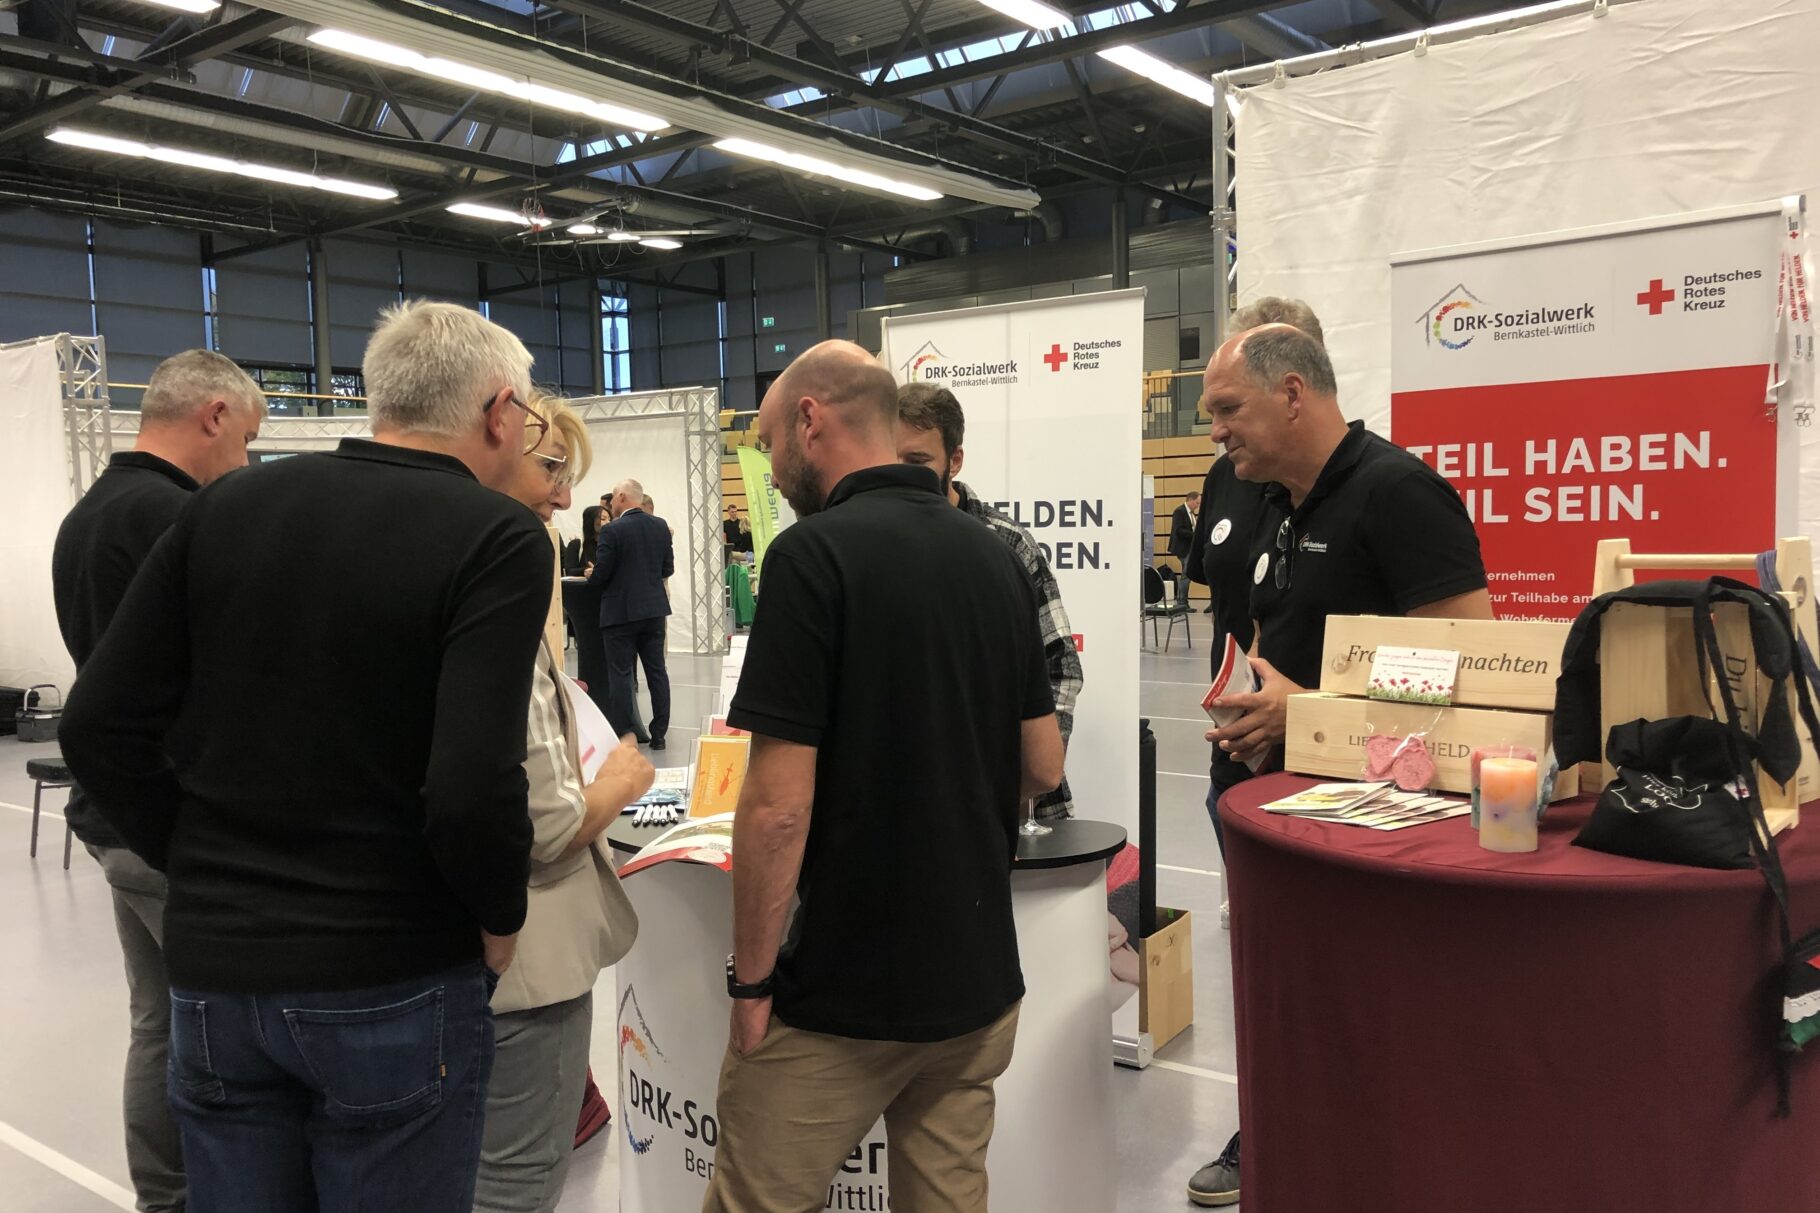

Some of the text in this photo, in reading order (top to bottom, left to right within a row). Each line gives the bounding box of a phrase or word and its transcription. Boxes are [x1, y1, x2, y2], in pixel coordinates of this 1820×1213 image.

[1684, 269, 1762, 286] Deutsches
[1684, 286, 1726, 299] Rotes
[1683, 299, 1726, 312] Kreuz
[1453, 302, 1595, 332] DRK-Sozialwerk
[1493, 321, 1595, 341] Bernkastel-Wittlich
[1073, 339, 1122, 351] Deutsches
[1073, 351, 1100, 361] Rotes
[925, 360, 1018, 379] DRK-Sozialwerk
[1073, 361, 1100, 371] Kreuz
[951, 376, 1018, 388] Bernkastel-Wittlich
[1524, 431, 1728, 476] HABEN.
[1457, 484, 1660, 524] IL SEIN.
[983, 499, 1114, 528] LDEN.
[1487, 570, 1556, 581] ernehmen
[1511, 592, 1569, 604] Teilhabe
[1461, 652, 1549, 675] nachten
